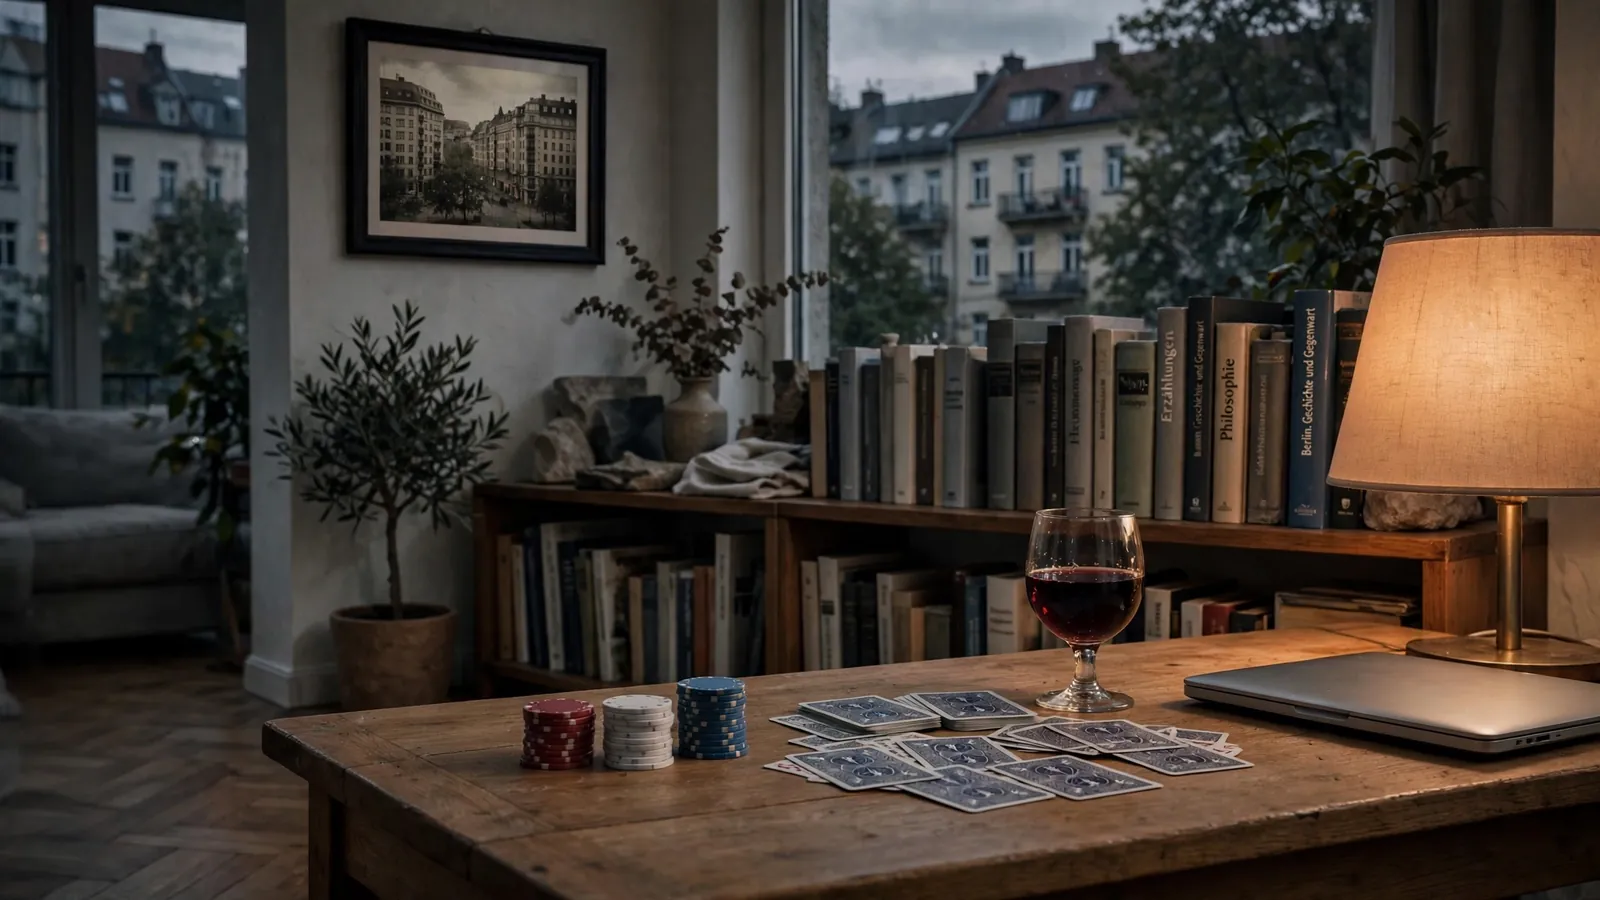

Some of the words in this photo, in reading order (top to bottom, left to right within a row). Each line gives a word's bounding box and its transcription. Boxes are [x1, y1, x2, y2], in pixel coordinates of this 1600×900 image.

[1304, 307, 1317, 358] Gegenwart
[1303, 360, 1314, 378] und
[1220, 358, 1238, 441] Philosophie
[1301, 425, 1312, 456] Berlin.
